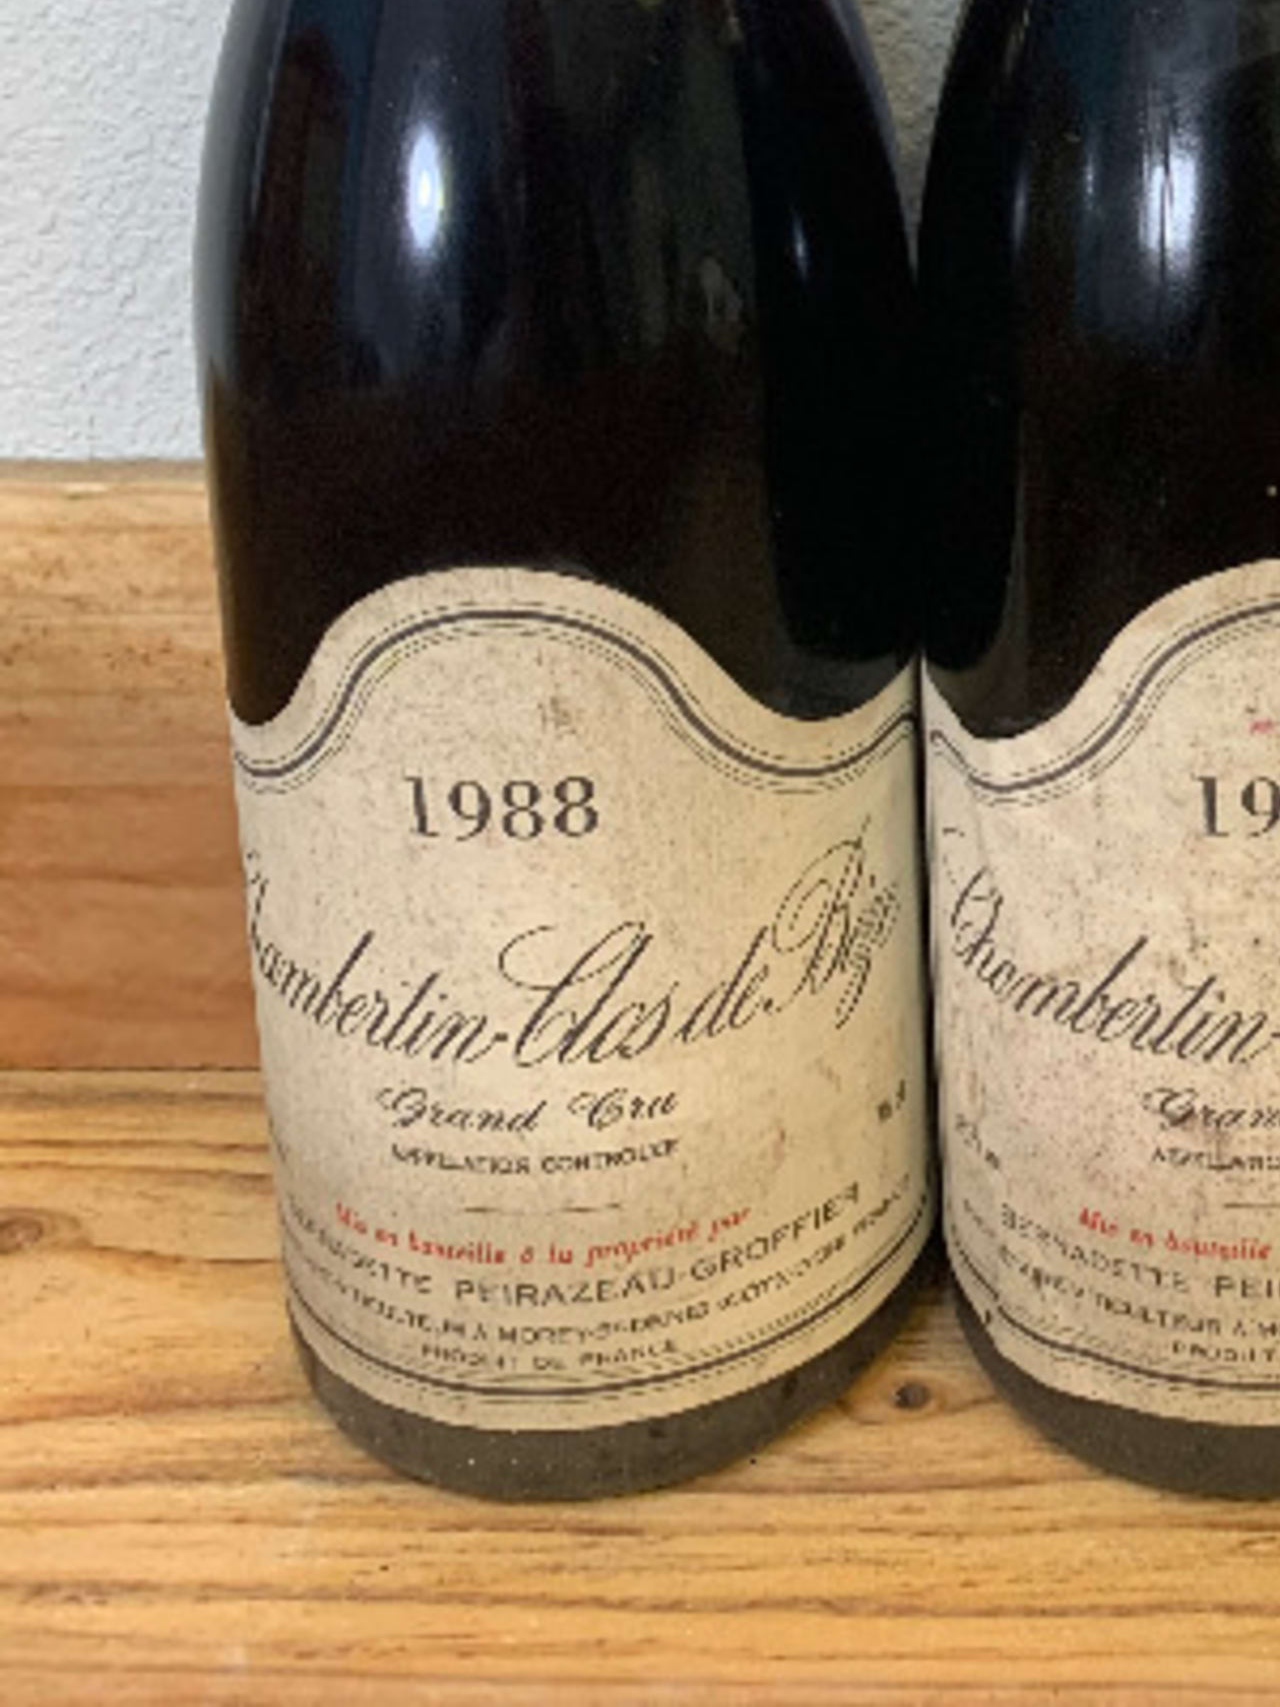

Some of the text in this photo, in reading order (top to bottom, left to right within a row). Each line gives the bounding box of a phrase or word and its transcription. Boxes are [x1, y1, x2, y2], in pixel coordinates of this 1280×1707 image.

[402, 775, 600, 841] 1988
[376, 1087, 680, 1133] Grand Cru
